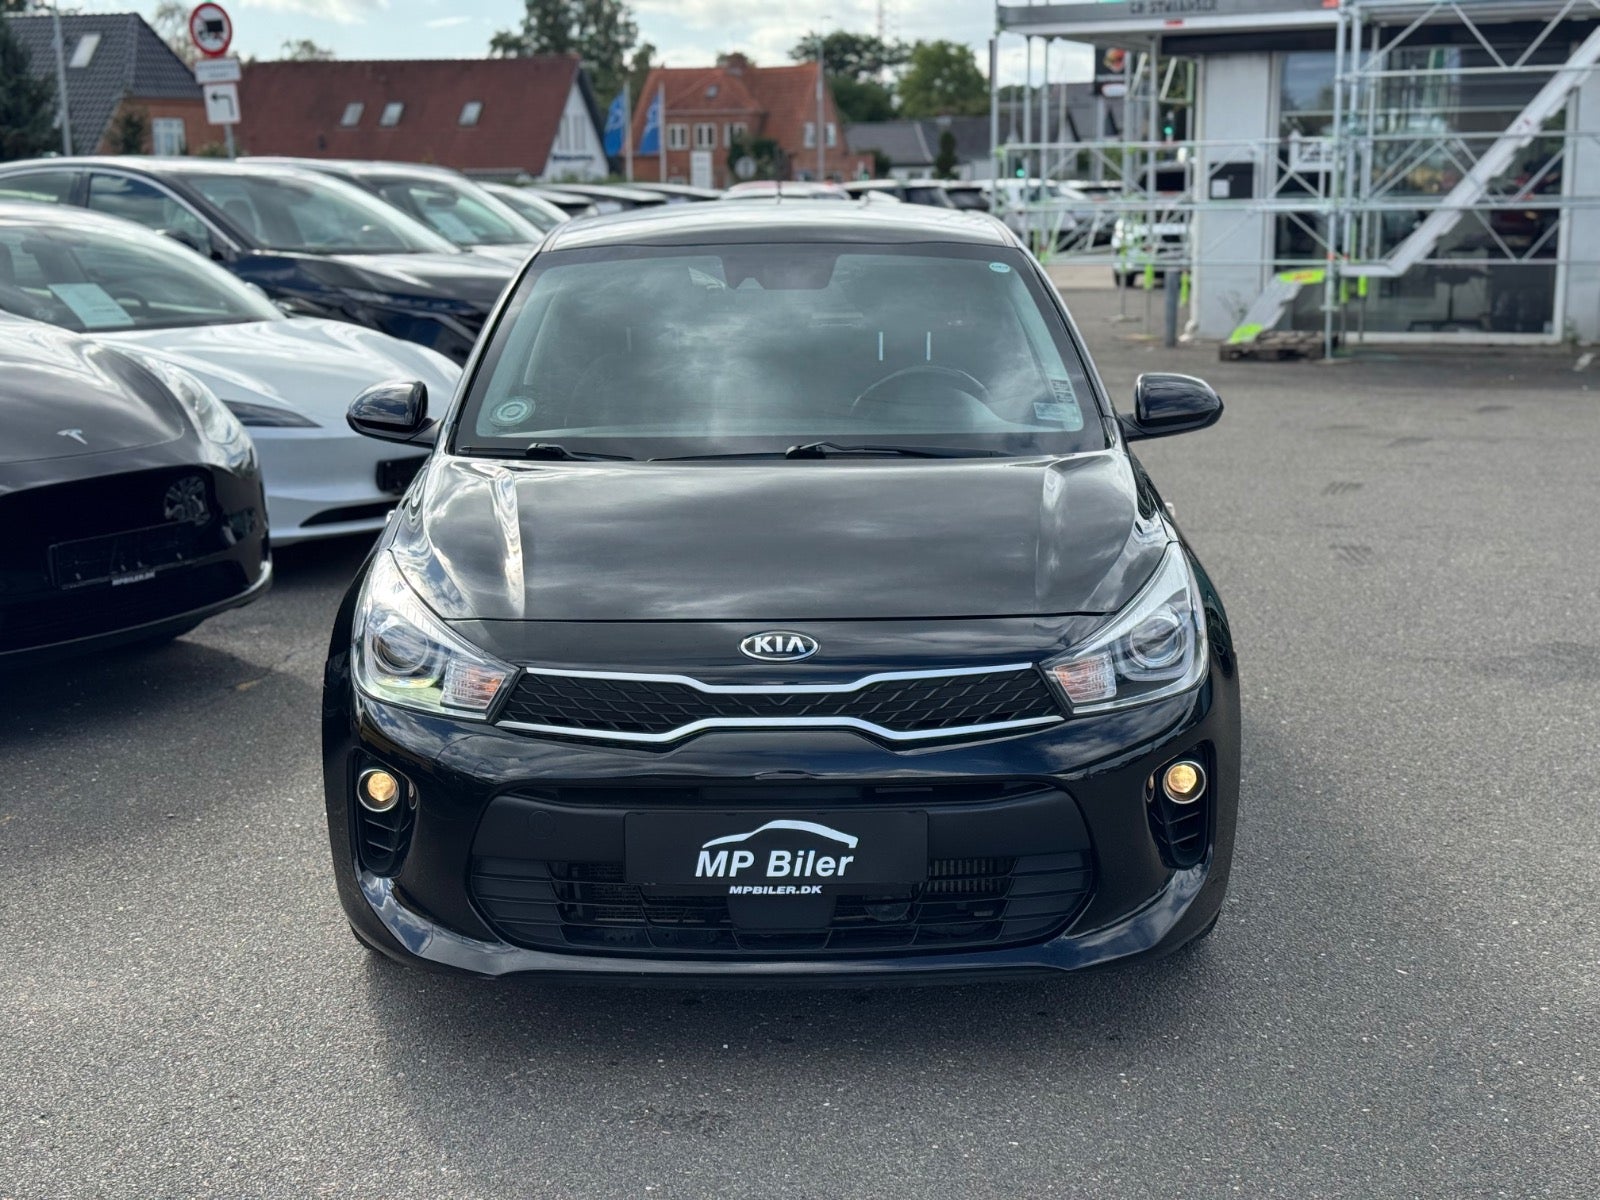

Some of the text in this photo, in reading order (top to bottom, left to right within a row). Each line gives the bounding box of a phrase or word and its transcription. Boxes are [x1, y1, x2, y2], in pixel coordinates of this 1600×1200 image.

[754, 635, 806, 653] KIA
[695, 850, 855, 877] MP Biler
[729, 885, 823, 895] MPBILER.DK
